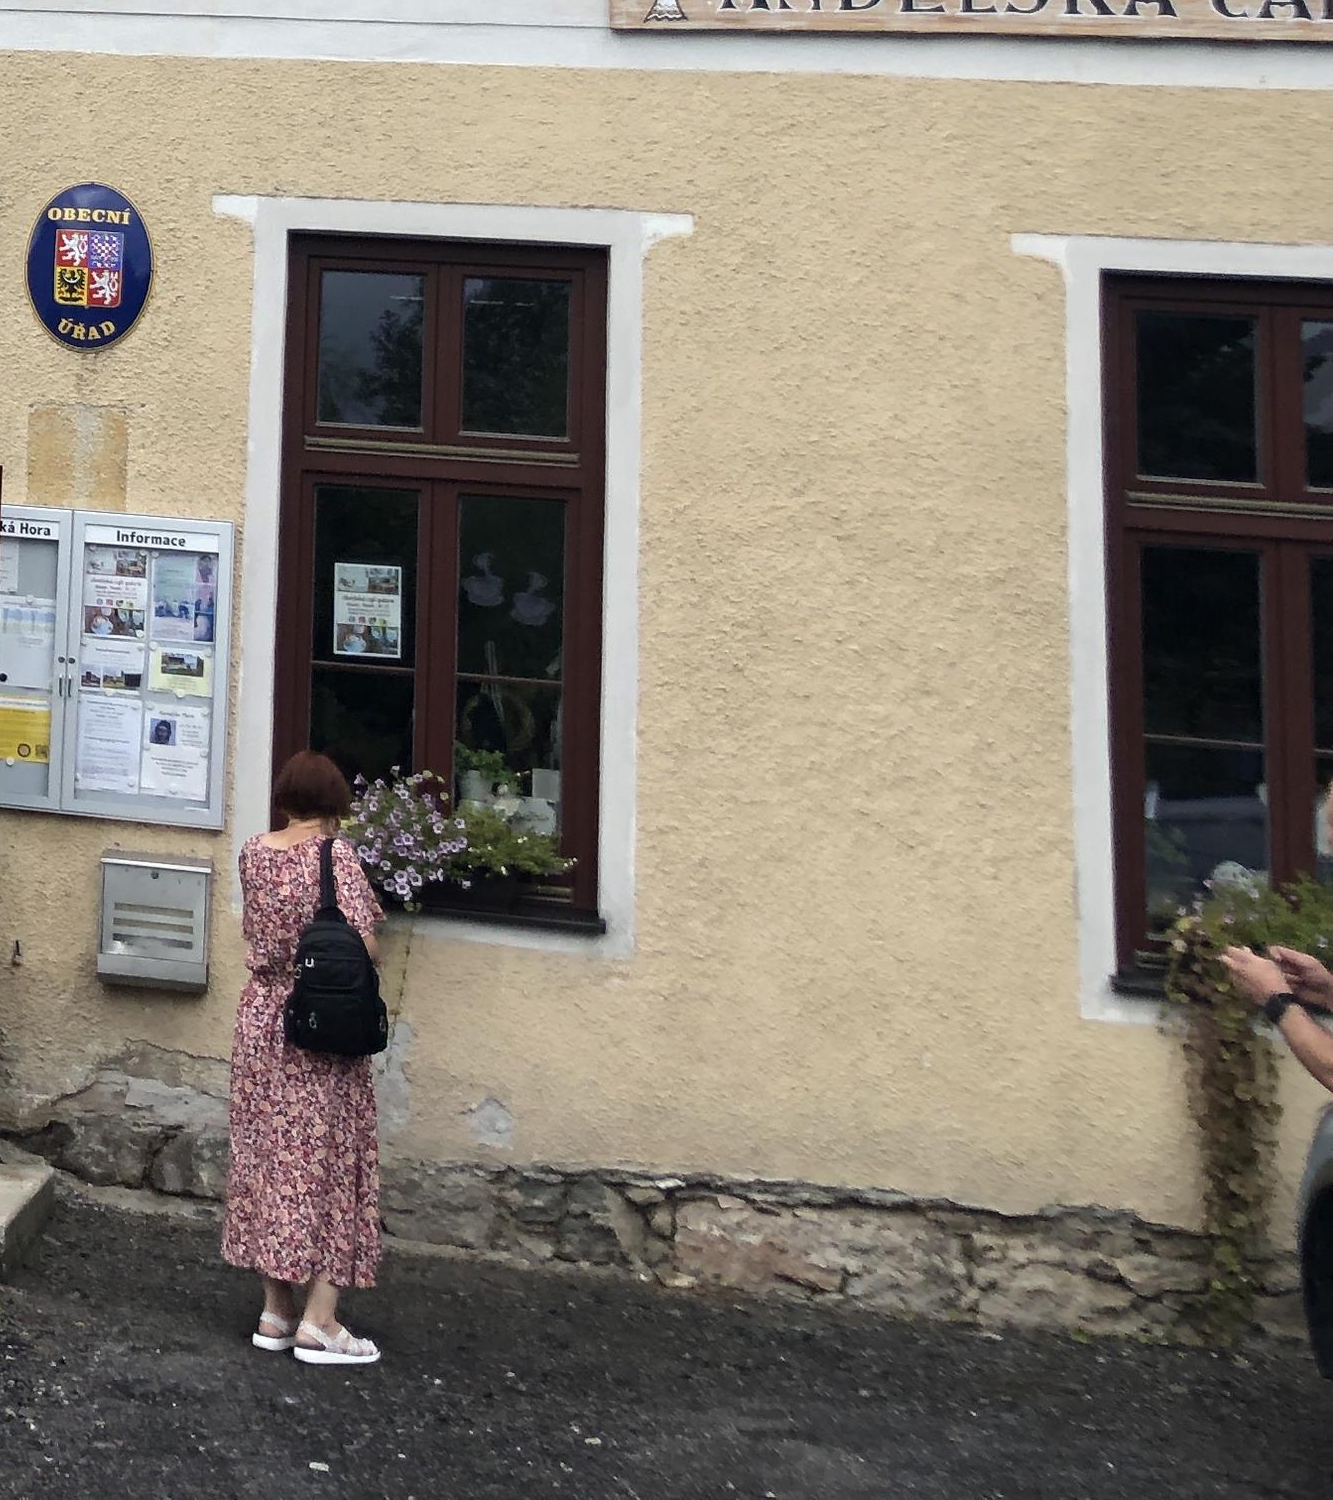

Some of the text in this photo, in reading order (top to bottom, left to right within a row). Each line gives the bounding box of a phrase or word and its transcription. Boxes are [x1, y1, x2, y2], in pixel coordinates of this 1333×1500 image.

[47, 207, 132, 226] OBECNÍ
[57, 317, 117, 341] ÚŘAD
[0, 520, 52, 537] ká Hora
[116, 530, 187, 547] Informace
